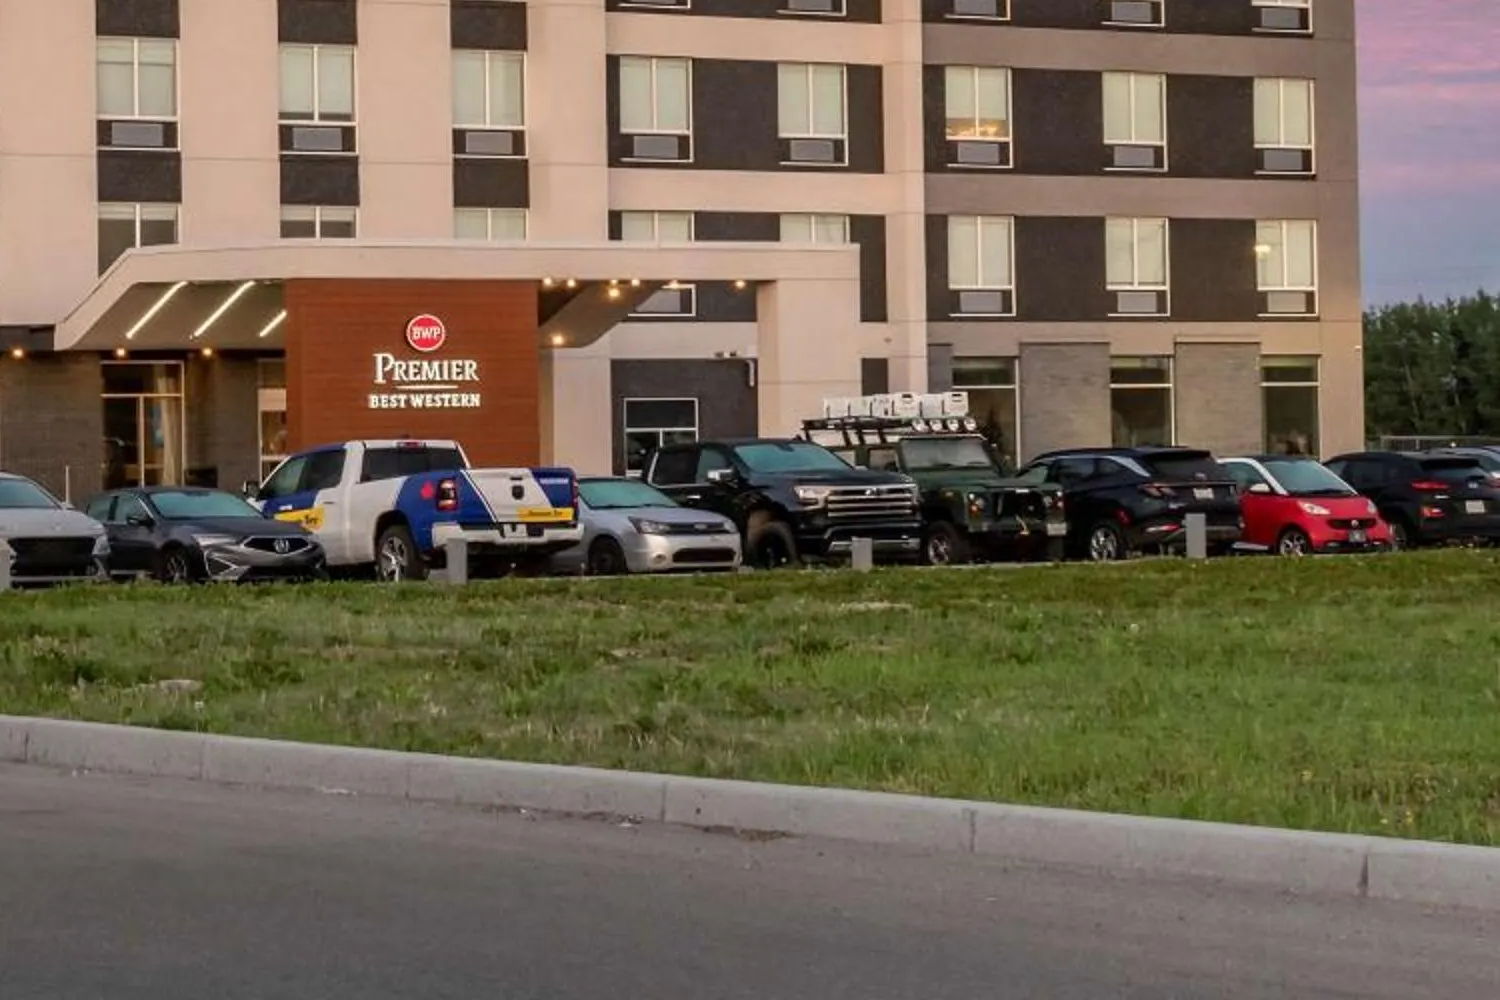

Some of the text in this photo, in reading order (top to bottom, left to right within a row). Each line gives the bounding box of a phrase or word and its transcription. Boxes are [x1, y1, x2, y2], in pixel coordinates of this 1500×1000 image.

[411, 326, 441, 340] BWP
[373, 352, 480, 384] PREMIER
[368, 393, 481, 409] BEST WESTERN
